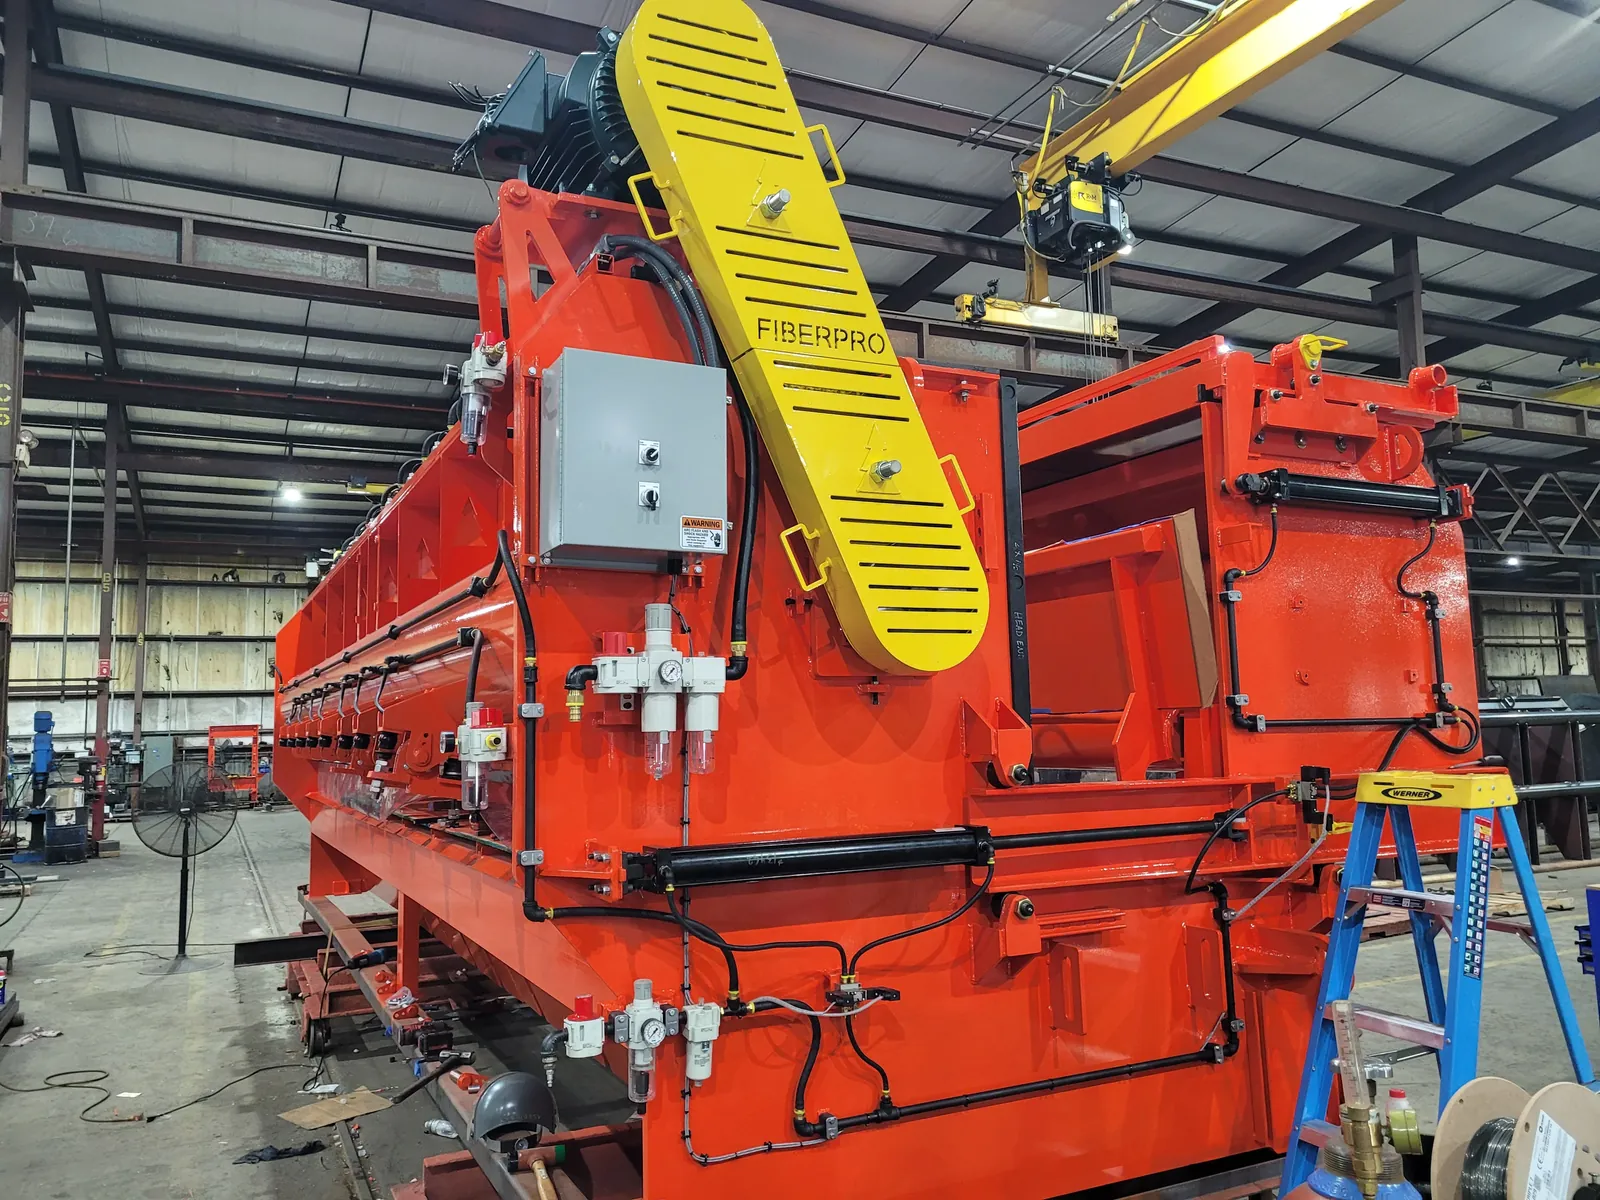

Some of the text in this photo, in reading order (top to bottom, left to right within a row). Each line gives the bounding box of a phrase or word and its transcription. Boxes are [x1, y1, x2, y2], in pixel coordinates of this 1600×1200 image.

[757, 317, 886, 355] FIBERPRO
[690, 519, 720, 528] WARNING
[1013, 611, 1024, 637] HEAD
[1393, 790, 1430, 798] WERNER
